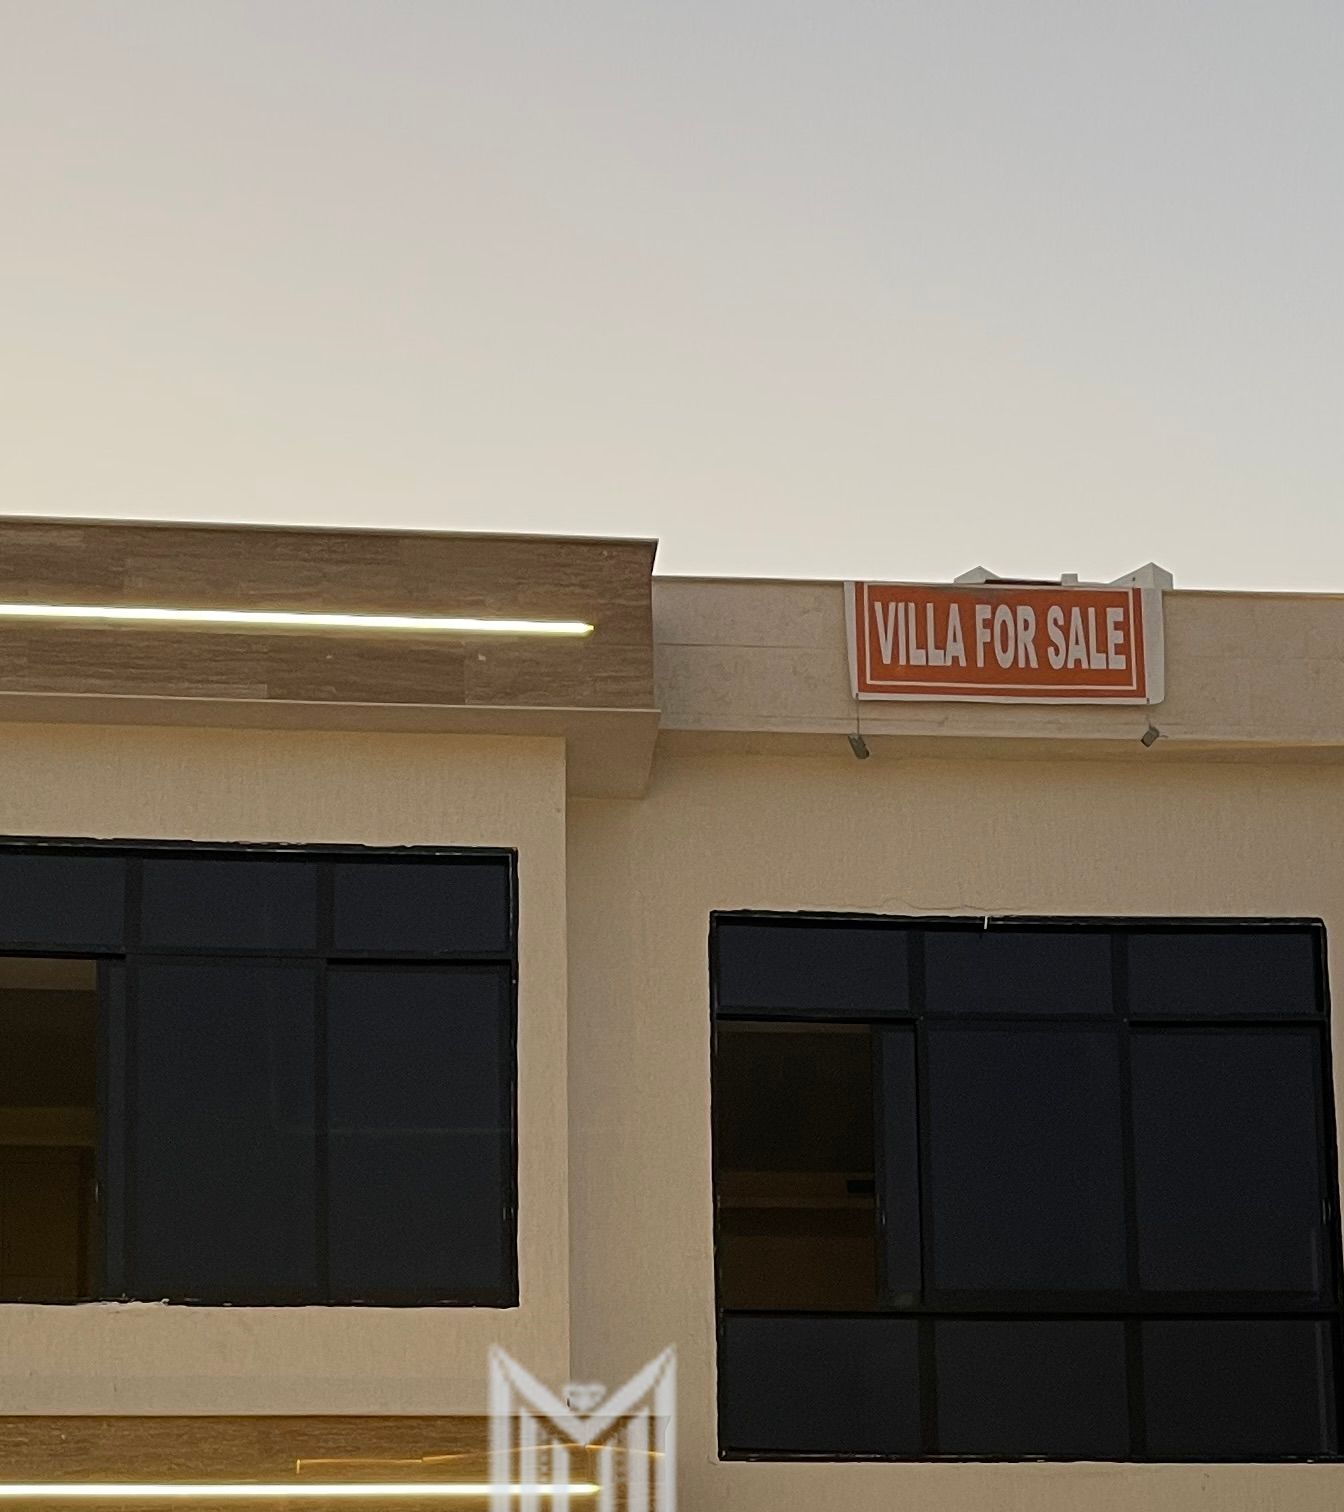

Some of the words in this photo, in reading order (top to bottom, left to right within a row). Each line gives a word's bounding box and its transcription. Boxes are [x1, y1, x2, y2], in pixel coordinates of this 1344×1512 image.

[873, 601, 967, 667] VILLA
[975, 603, 1039, 669] FOR
[1047, 604, 1127, 670] SALE
